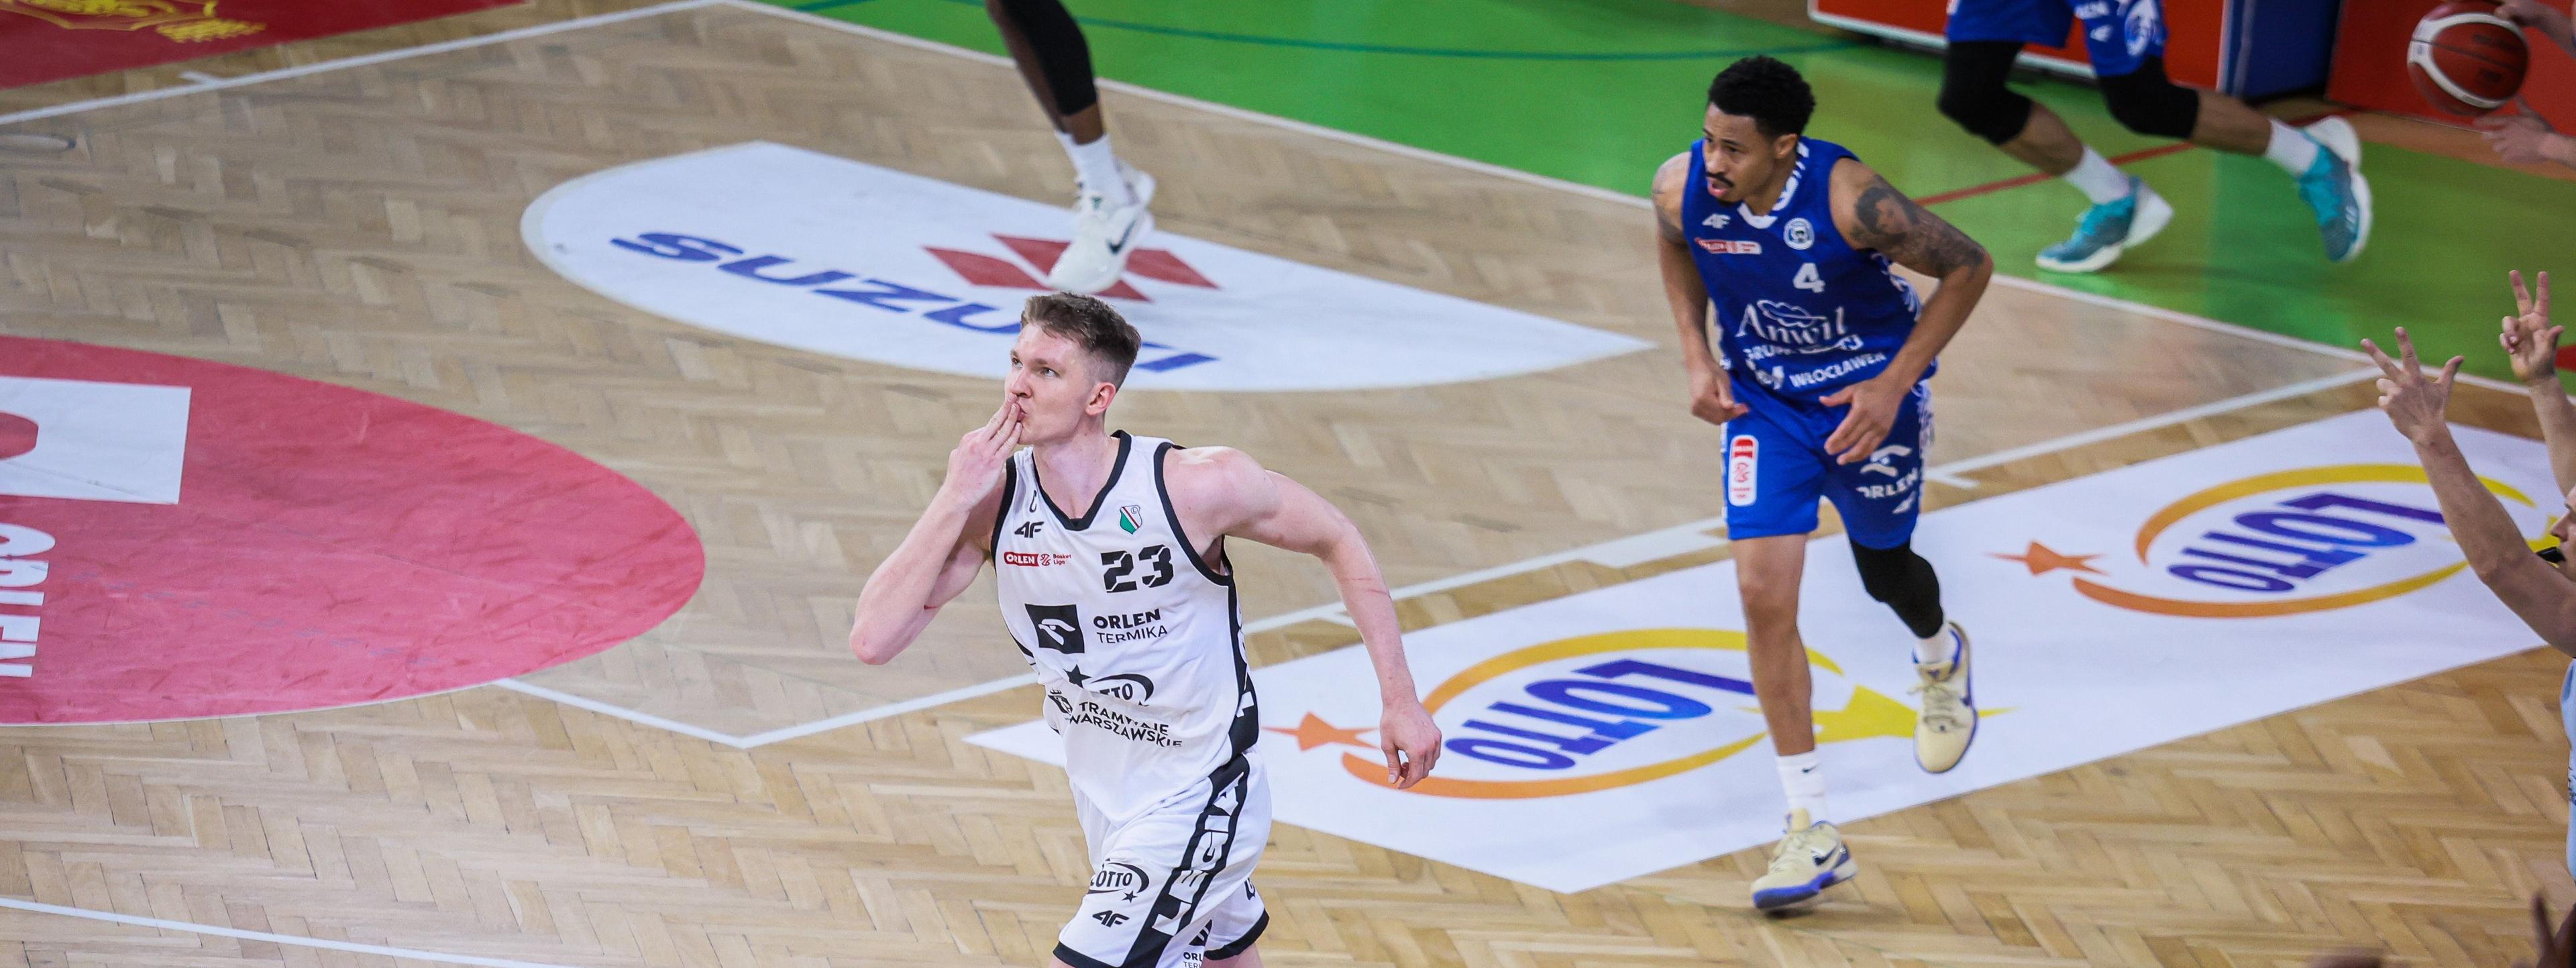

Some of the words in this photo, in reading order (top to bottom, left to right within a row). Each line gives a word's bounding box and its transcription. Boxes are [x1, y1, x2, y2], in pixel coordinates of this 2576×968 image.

[1792, 262, 1825, 293] 4
[610, 231, 1220, 373] SUZUI
[1014, 521, 1044, 539] 4F
[2168, 492, 2446, 593] LOTTO
[1006, 553, 1035, 564] ORLEN
[1100, 544, 1174, 594] 23
[1093, 608, 1161, 629] ORLEN
[1096, 625, 1169, 644] TERMIKA
[1445, 659, 1757, 771] LOTTO
[1152, 771, 1244, 936] LEGIA
[1092, 910, 1130, 928] 4F
